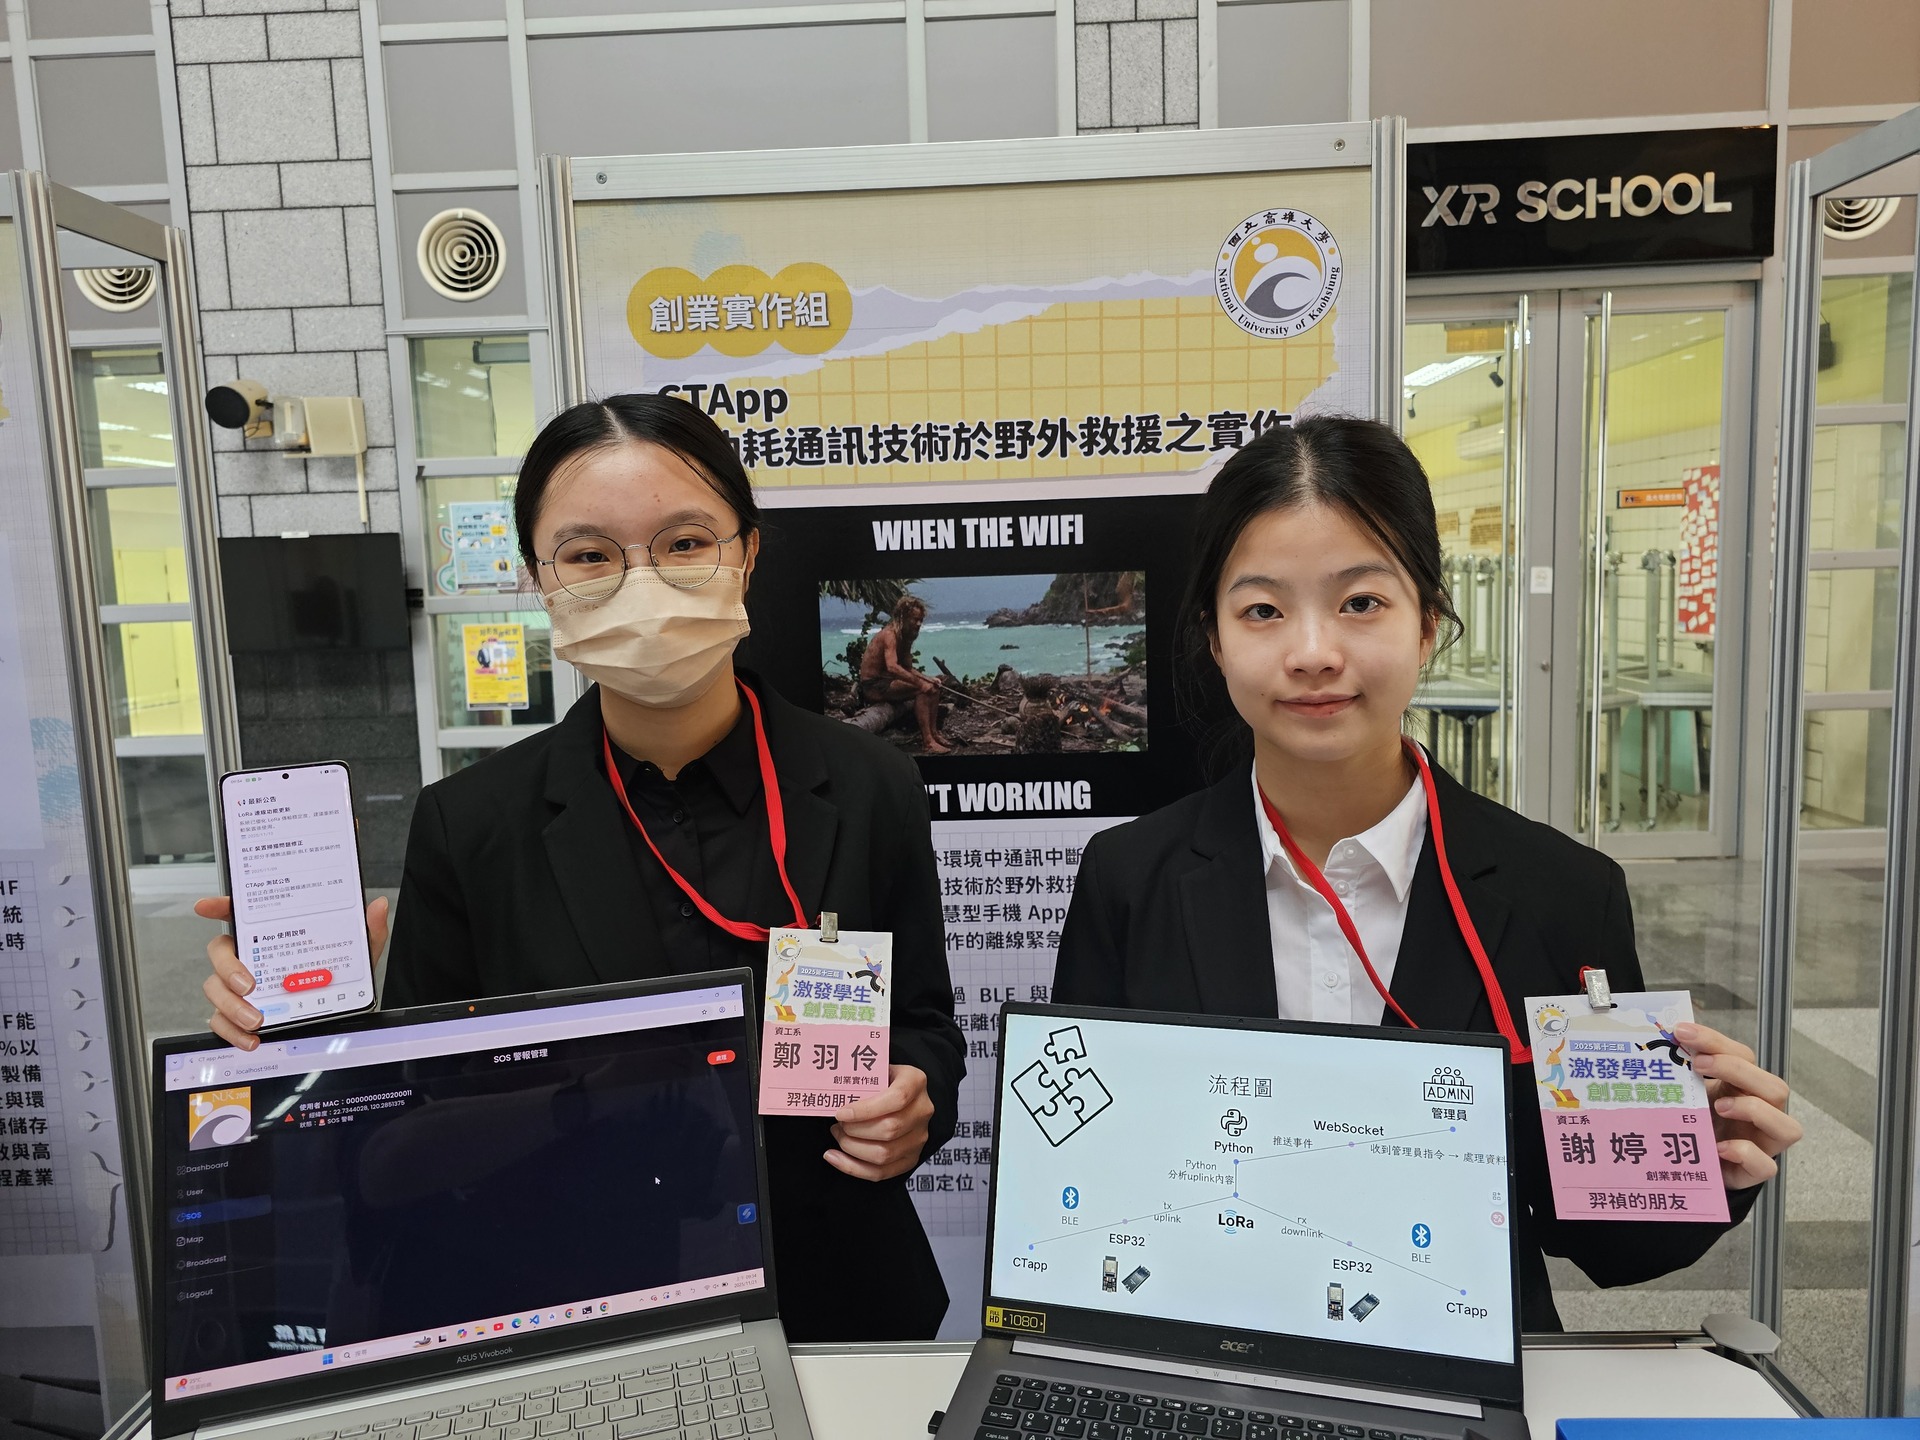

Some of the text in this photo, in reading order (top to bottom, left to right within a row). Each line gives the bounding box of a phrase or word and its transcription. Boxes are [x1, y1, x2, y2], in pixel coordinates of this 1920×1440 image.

[1420, 172, 1732, 228] XR SCHOOL
[1228, 211, 1331, 247] 國立高雄大學
[1218, 266, 1340, 336] National University of Kaohsiung
[648, 291, 831, 333] 創業實作組
[872, 514, 1084, 551] WHEN THE WIFI
[924, 780, 1091, 813] 'T WORKING
[245, 881, 264, 889] CTApp
[939, 875, 1077, 897] 技術於野外救
[2, 905, 23, 924] 統
[942, 903, 1066, 924] 慧型手機 App
[0, 931, 25, 951] 時
[262, 928, 306, 941] App 使用說明
[793, 979, 872, 1004] 激發學生
[980, 987, 1016, 1002] BLE
[1029, 985, 1048, 1003] 與
[802, 1001, 876, 1022] 創意競賽
[3, 1012, 36, 1031] F能
[775, 1027, 801, 1036] 資工系
[870, 1031, 880, 1039] E5
[493, 1049, 548, 1063] SOS 警報管理
[1, 1064, 41, 1083] 製備
[1568, 1057, 1676, 1081] 激發學生
[833, 1075, 879, 1085] 創業實作組
[1208, 1074, 1273, 1098] 流程圖
[0, 1090, 45, 1109] 與環
[1427, 1087, 1471, 1101] ADMIN
[1586, 1082, 1685, 1104] 創意競賽
[299, 1103, 321, 1111] 使用者
[1431, 1107, 1468, 1122] 管理員
[1556, 1115, 1591, 1126] 資工系
[1683, 1114, 1697, 1124] E5
[1313, 1120, 1384, 1136] WebSocket
[1214, 1141, 1253, 1155] Python
[1272, 1136, 1313, 1149] 推送事件
[926, 1147, 991, 1166] 臨時通
[186, 1161, 229, 1173] Dashboard
[1185, 1159, 1217, 1171] Python
[1168, 1169, 1235, 1185] 分析uplink內容
[1646, 1171, 1708, 1182] 創業實作組
[186, 1188, 204, 1196] User
[1163, 1202, 1172, 1210] tx
[1589, 1192, 1688, 1211] 羿禎的朋友
[185, 1212, 202, 1220] SOS
[1061, 1216, 1079, 1226] BLE
[1154, 1212, 1181, 1224] uplink
[1217, 1213, 1254, 1229] LoRa
[1281, 1225, 1324, 1239] downlink
[186, 1235, 204, 1245] Map
[1109, 1233, 1145, 1247] ESP32
[186, 1255, 227, 1268] Broadcast
[1012, 1257, 1048, 1272] CTapp
[1333, 1258, 1373, 1274] ESP32
[1411, 1253, 1431, 1264] BLE
[186, 1288, 214, 1300] Logout
[1446, 1302, 1488, 1319] CTapp
[990, 1315, 999, 1323] HD
[1009, 1313, 1038, 1328] 1080
[1219, 1340, 1255, 1353] acer
[456, 1346, 513, 1364] ASUS Vivobook
